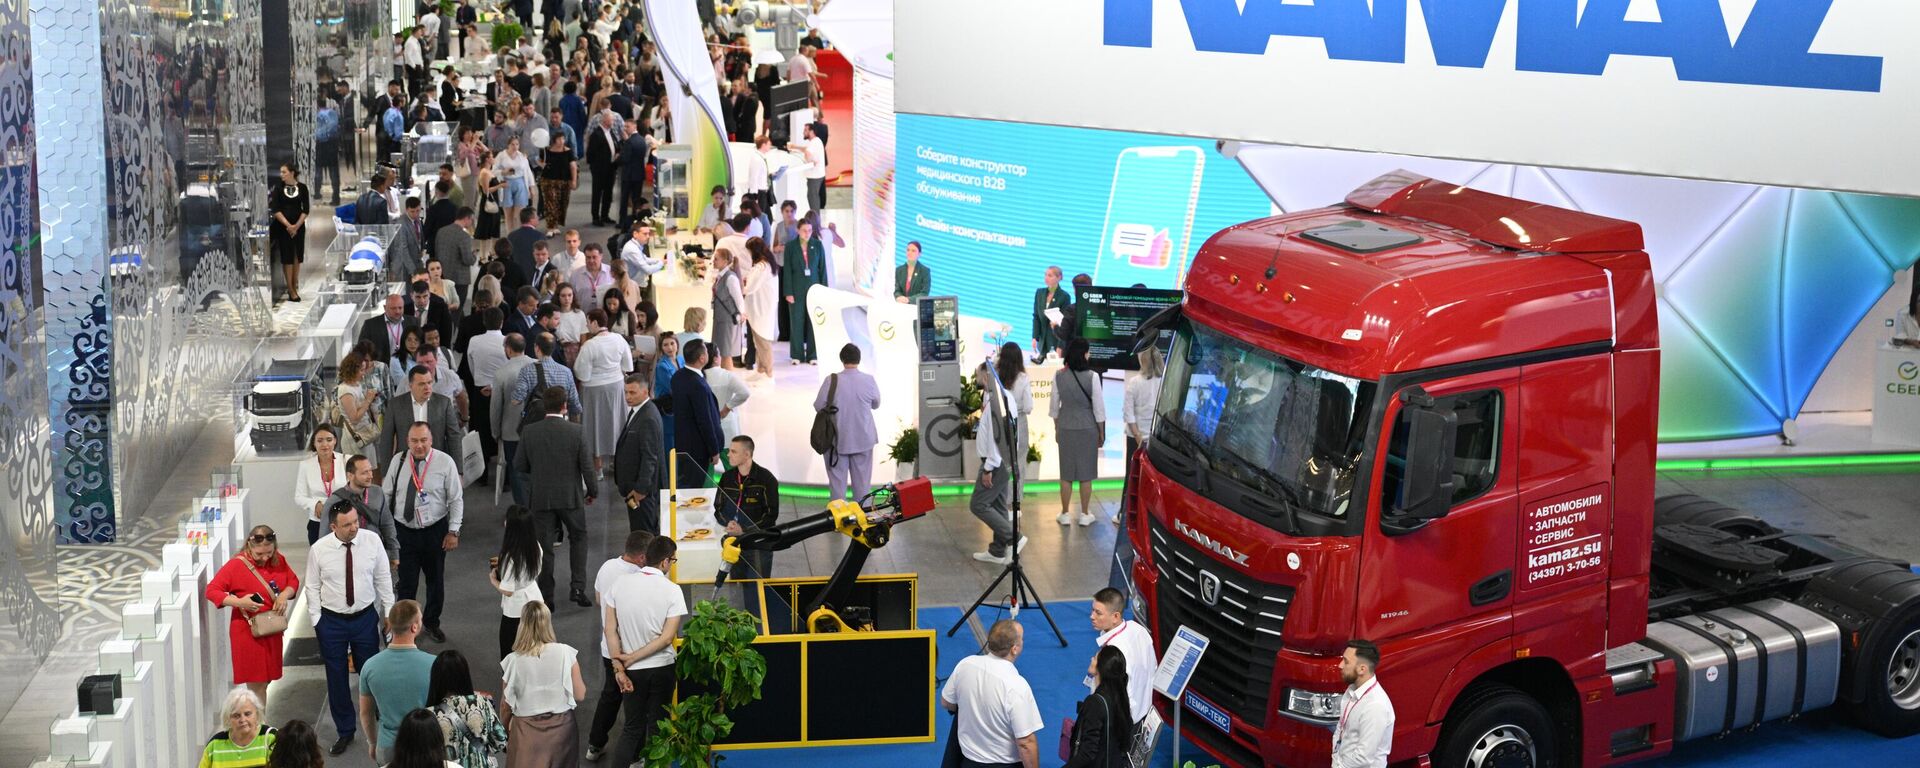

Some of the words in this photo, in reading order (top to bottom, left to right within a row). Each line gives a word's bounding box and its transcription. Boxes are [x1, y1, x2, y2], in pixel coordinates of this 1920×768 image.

[916, 145, 959, 165] Соберите
[960, 156, 1027, 177] конструктор
[916, 165, 982, 187] медицинского
[916, 180, 982, 204] обслуживания
[915, 213, 1026, 247] Онлайн-консультации
[1886, 382, 1920, 396] СБЕ
[1535, 494, 1602, 518] АВТОМОБИЛИ
[1535, 511, 1586, 531] ЗАПЧАСТИ
[1174, 518, 1250, 567] KAMAZ
[1535, 528, 1574, 545] СЕРВИС
[1528, 541, 1602, 569] kamaz.su
[1528, 565, 1565, 583] (34397)
[1566, 556, 1601, 572] 3-70-56
[1187, 694, 1228, 727] ТЕМИР-ТЕКС
